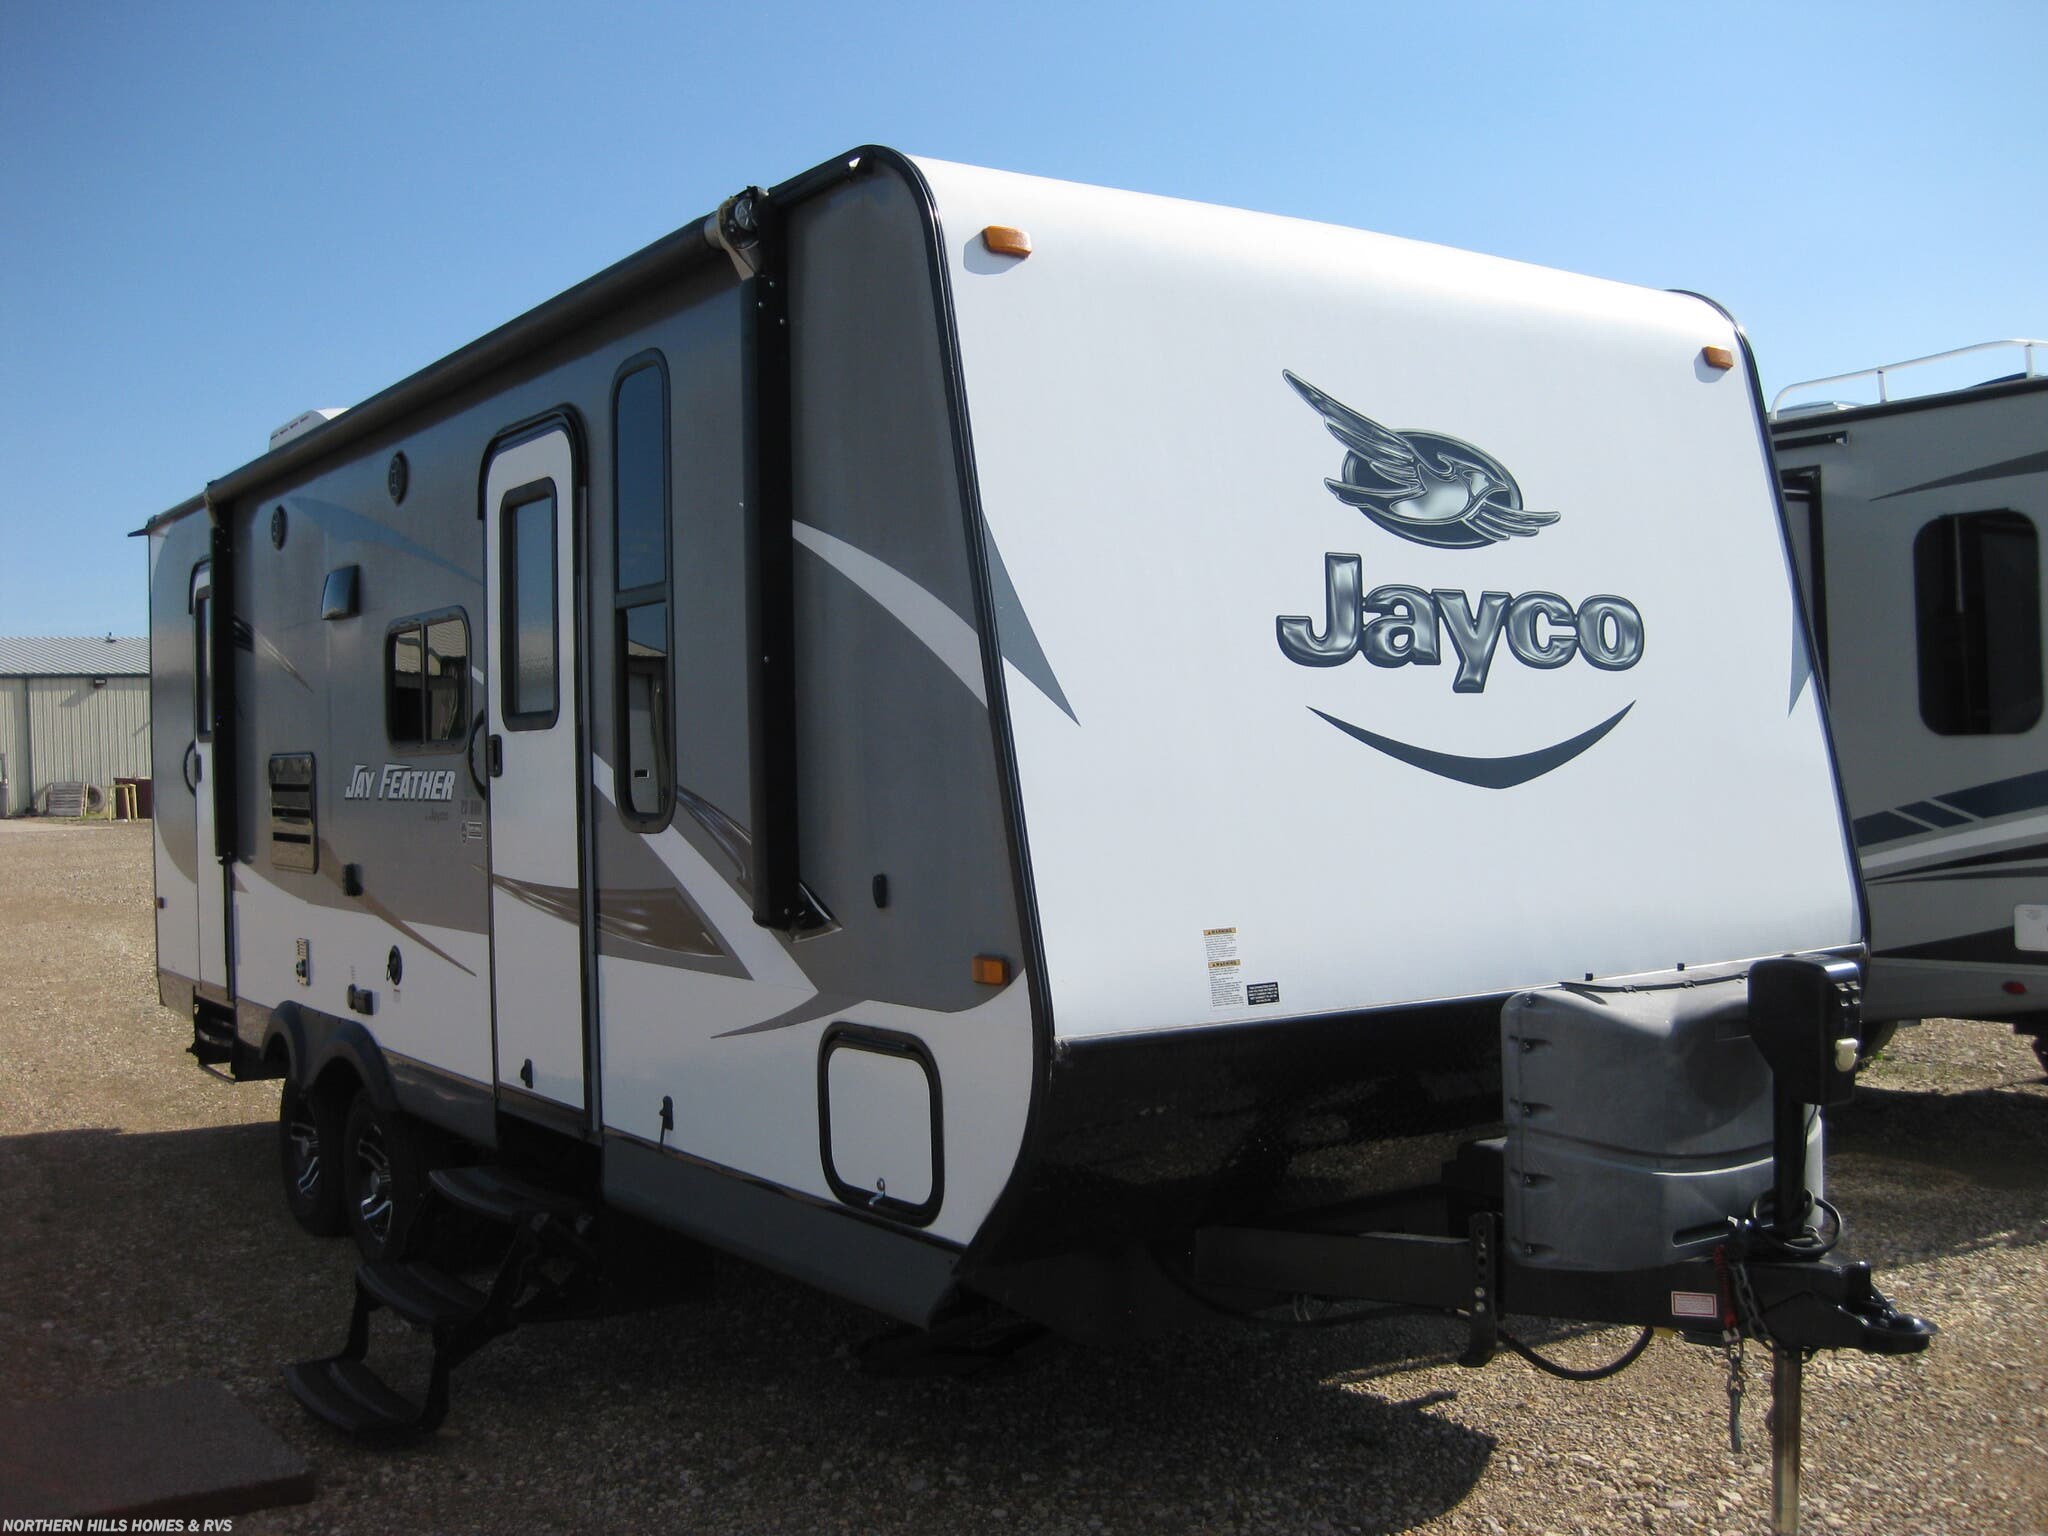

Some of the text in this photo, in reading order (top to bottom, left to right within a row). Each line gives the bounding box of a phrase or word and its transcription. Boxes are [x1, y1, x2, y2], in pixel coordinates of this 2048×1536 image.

[1276, 552, 1645, 693] Jayco
[345, 763, 456, 801] JAY FEATHER
